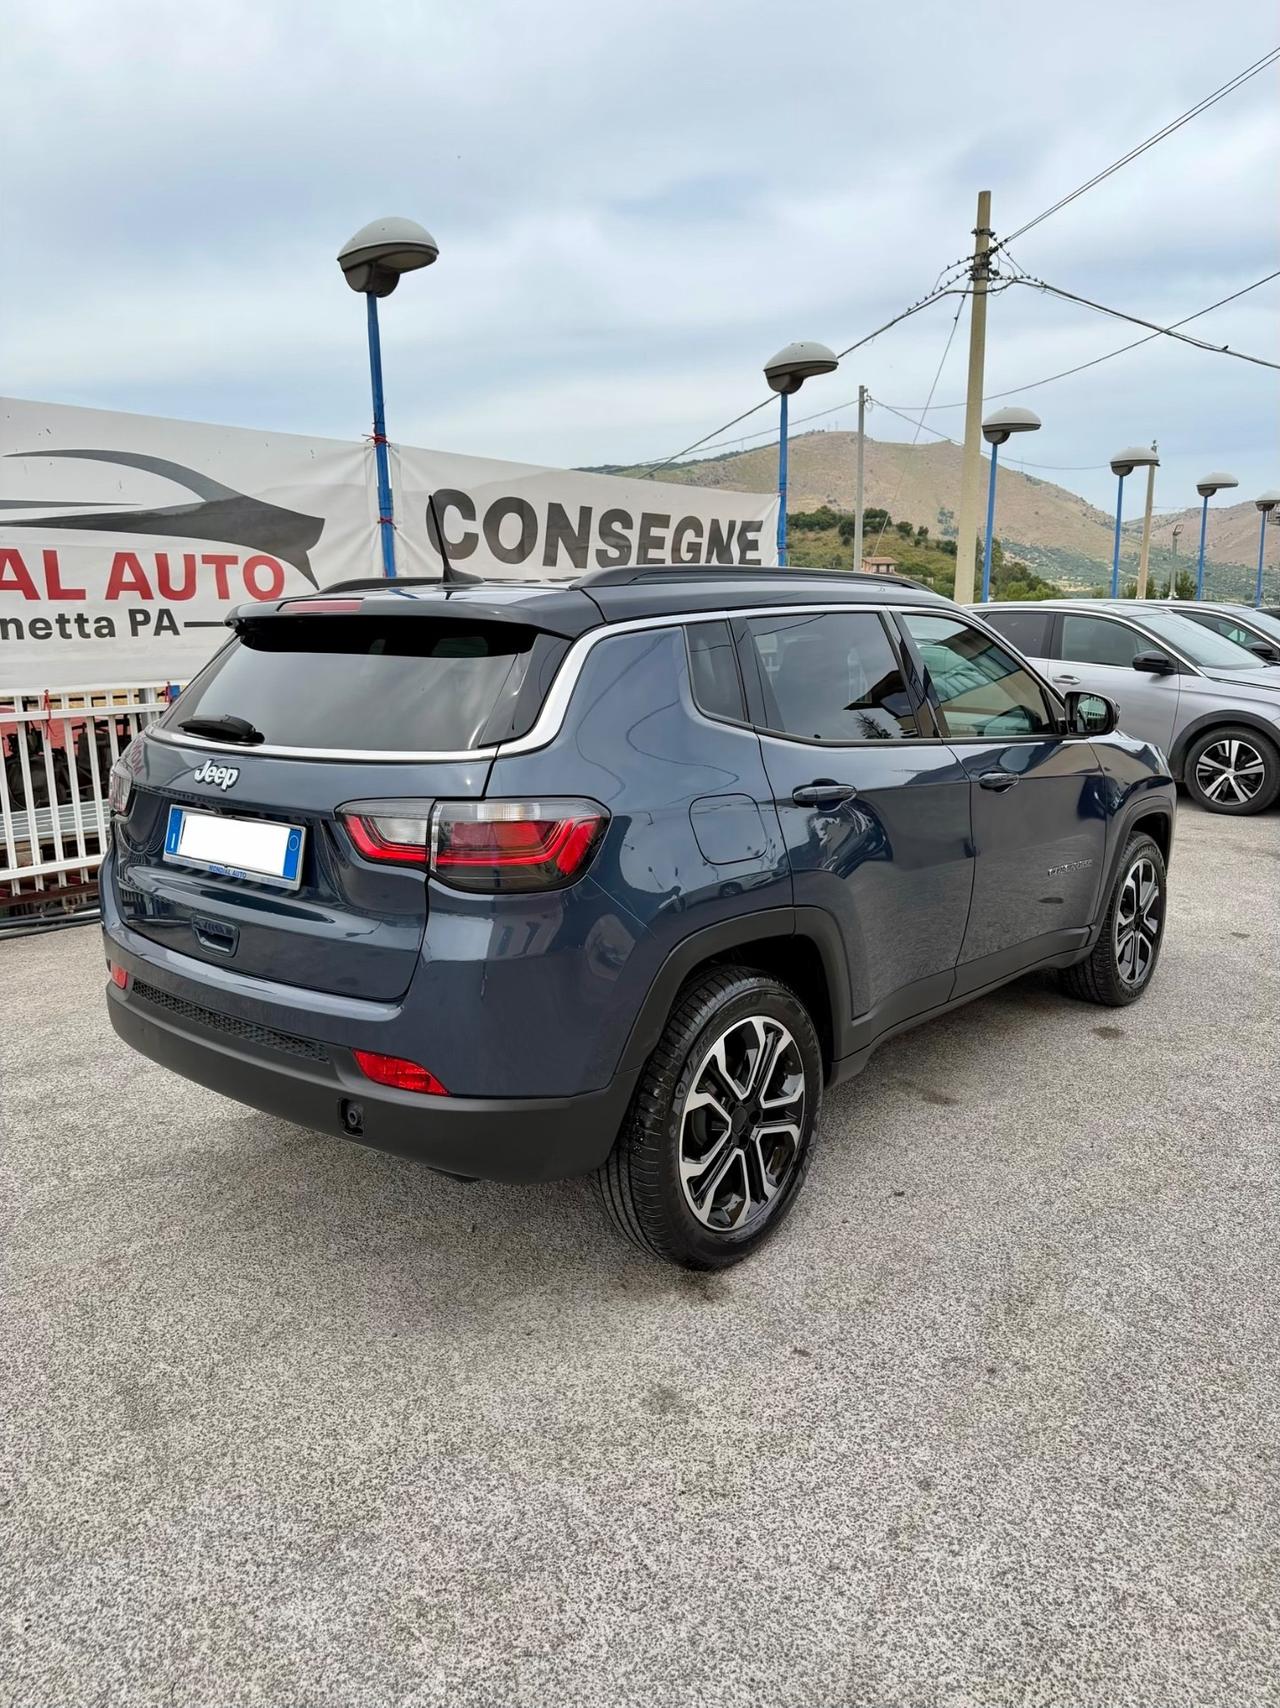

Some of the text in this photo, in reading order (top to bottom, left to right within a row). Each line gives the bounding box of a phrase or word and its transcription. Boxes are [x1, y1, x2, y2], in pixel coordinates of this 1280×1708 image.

[426, 488, 763, 568] CONSEGNE
[0, 548, 285, 601] AL AUTO
[0, 608, 181, 640] netta PA
[194, 759, 239, 791] Jeep
[231, 869, 247, 879] AUTO
